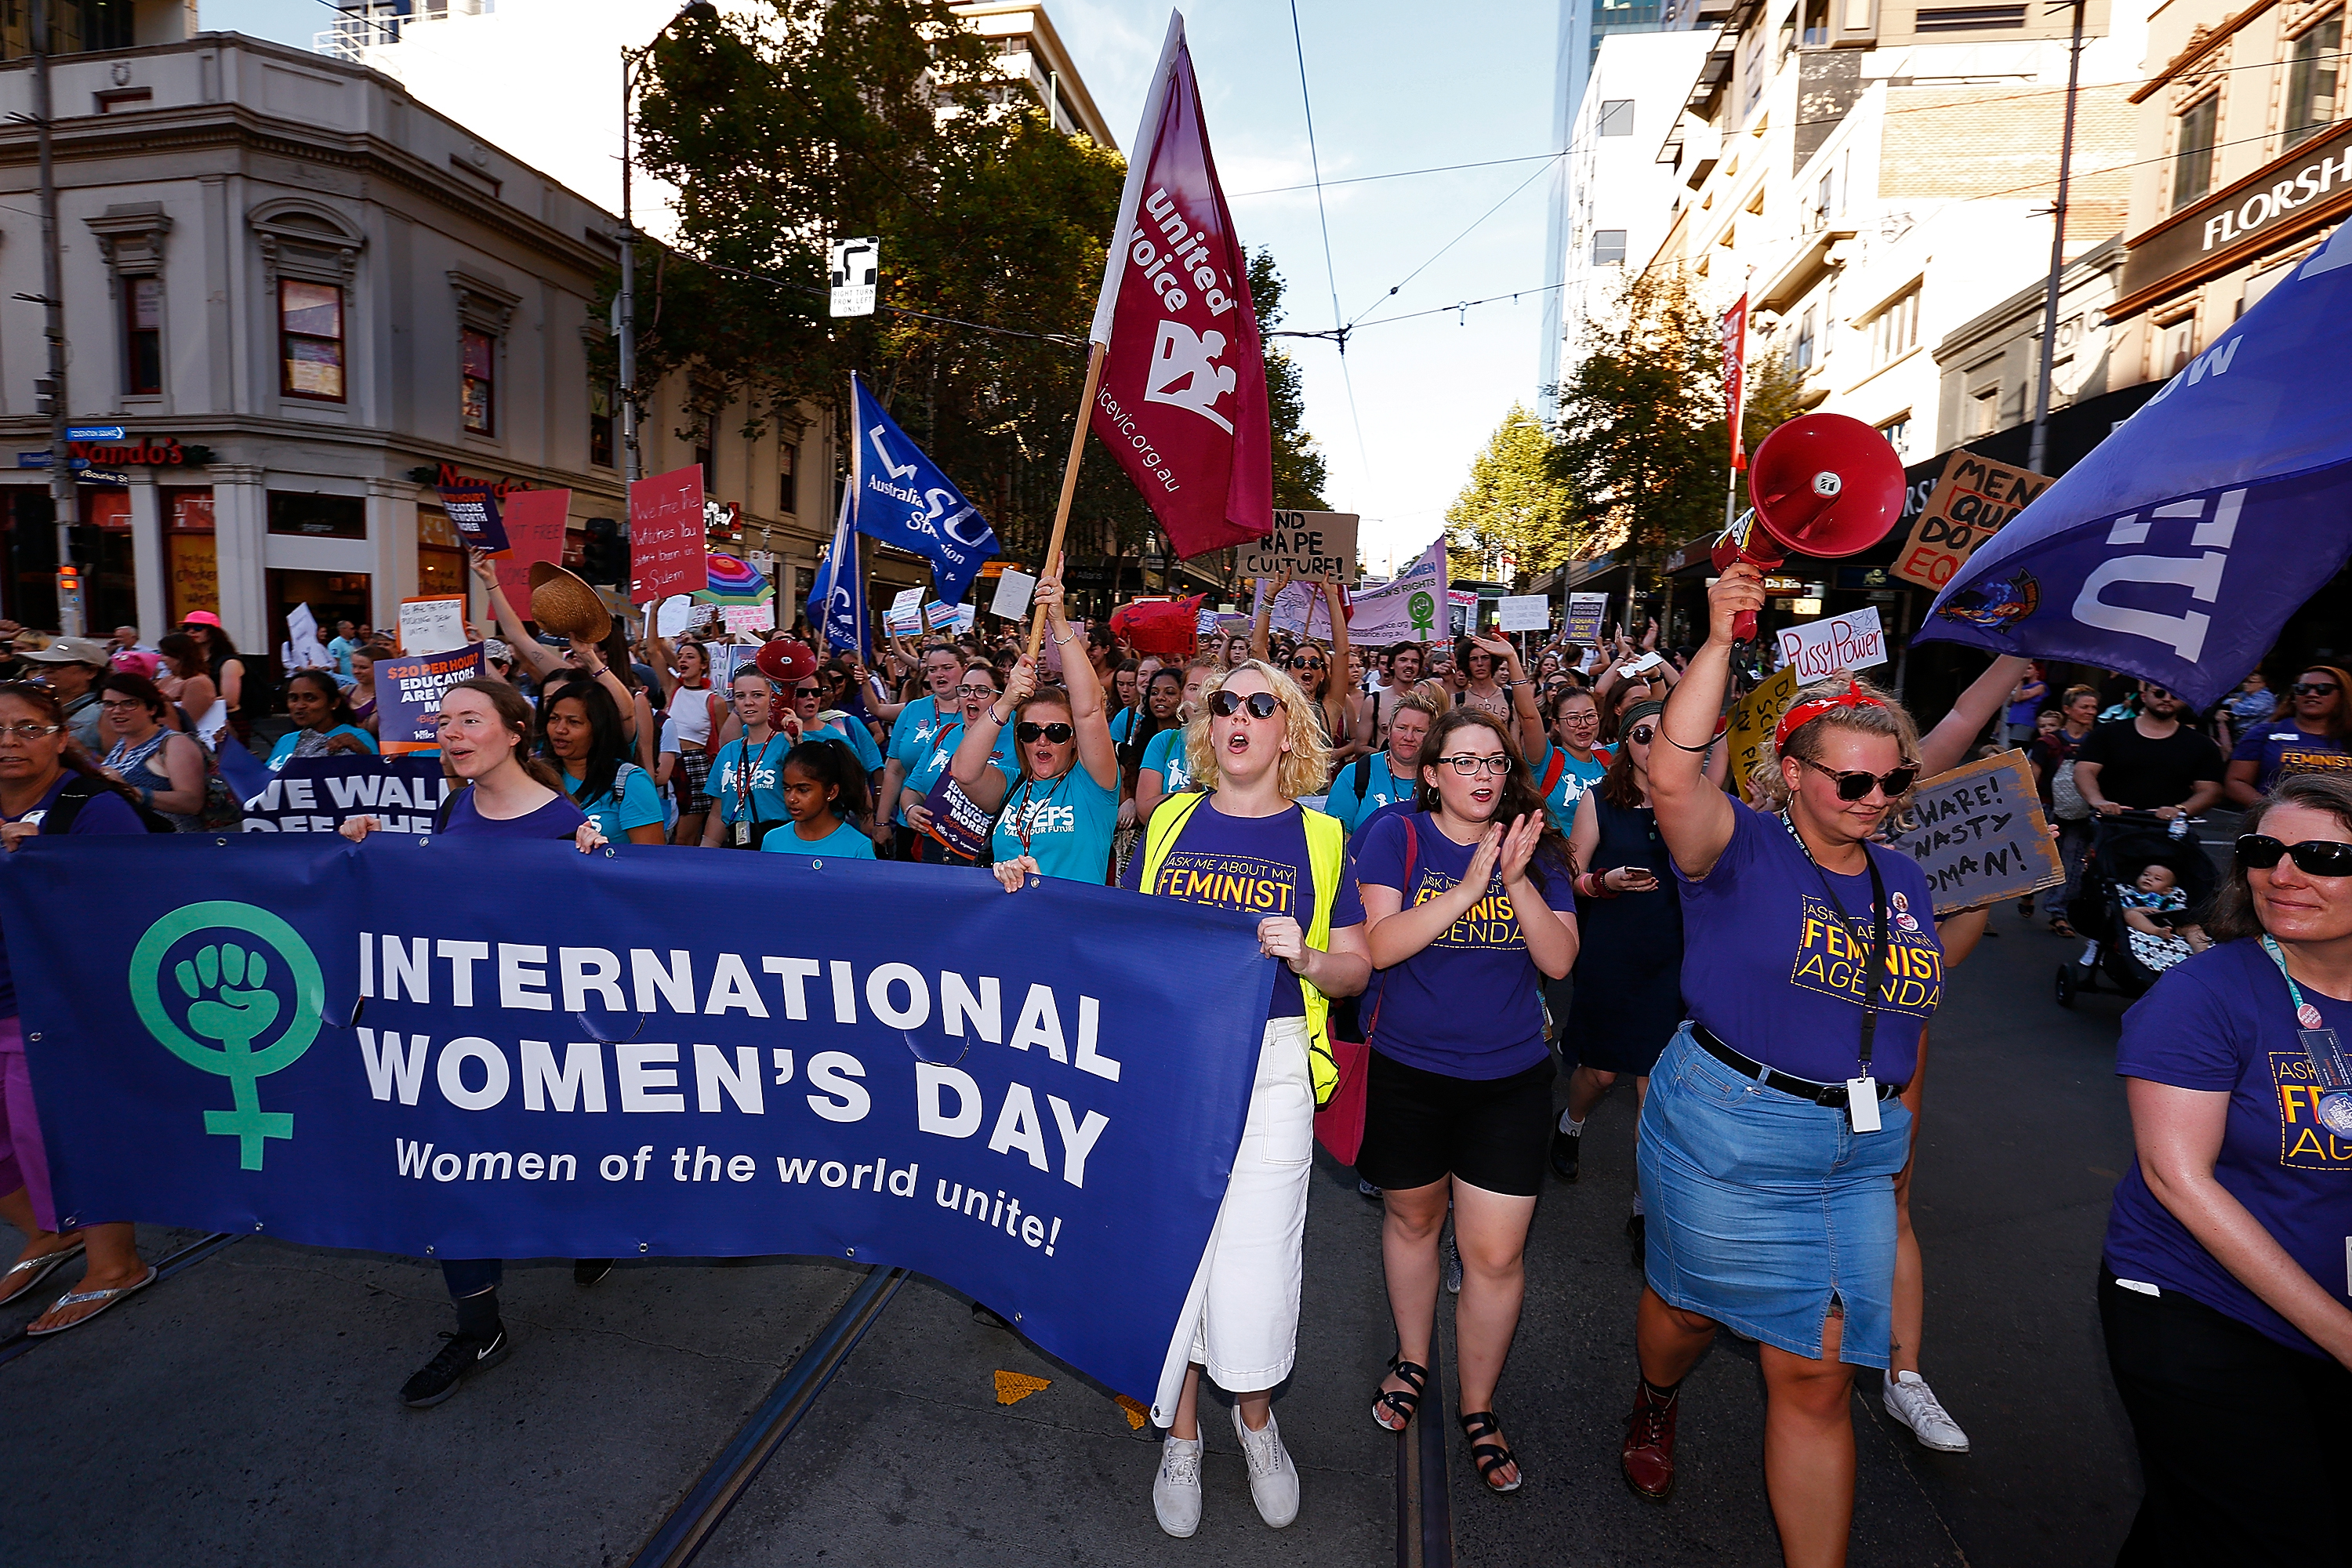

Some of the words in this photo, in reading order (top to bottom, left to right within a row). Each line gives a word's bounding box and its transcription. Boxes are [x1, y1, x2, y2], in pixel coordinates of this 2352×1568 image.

[1145, 187, 1233, 317] united
[85, 470, 117, 481] Bourke
[1952, 459, 2045, 507] MEN
[678, 485, 700, 510] The
[868, 474, 926, 510] Australia
[677, 518, 697, 538] You
[1272, 511, 1305, 530] ND
[1247, 556, 1344, 581] CULTURE!
[1402, 578, 1436, 593] RIGHTS
[1784, 633, 1834, 677] Pussy
[1831, 620, 1881, 666] Power
[387, 666, 420, 681] $20
[420, 663, 449, 677] PER
[449, 652, 480, 671] HOUR?
[399, 666, 475, 691] EDUCATORS
[401, 689, 437, 704] ARE
[949, 807, 987, 837] MORE!
[963, 804, 990, 829] WOR
[1047, 824, 1075, 834] FUTURE
[1915, 811, 2013, 862] NASTY
[1167, 856, 1194, 867] ASK
[1193, 858, 1217, 871] ME
[1218, 860, 1269, 877] ABOUT
[1271, 867, 1294, 882] MY
[1925, 840, 2027, 892] OMAN!
[1157, 868, 1293, 912] FEMINIST
[1423, 873, 1443, 890] ASK
[359, 931, 1121, 1083] INTERNATIONAL
[356, 1026, 872, 1123] WOMEN'S
[915, 1061, 1110, 1189] DAY
[396, 1138, 577, 1182] Women
[599, 1145, 654, 1181] of
[671, 1146, 756, 1182] the
[775, 1156, 919, 1198] world
[935, 1178, 1062, 1258] unite!
